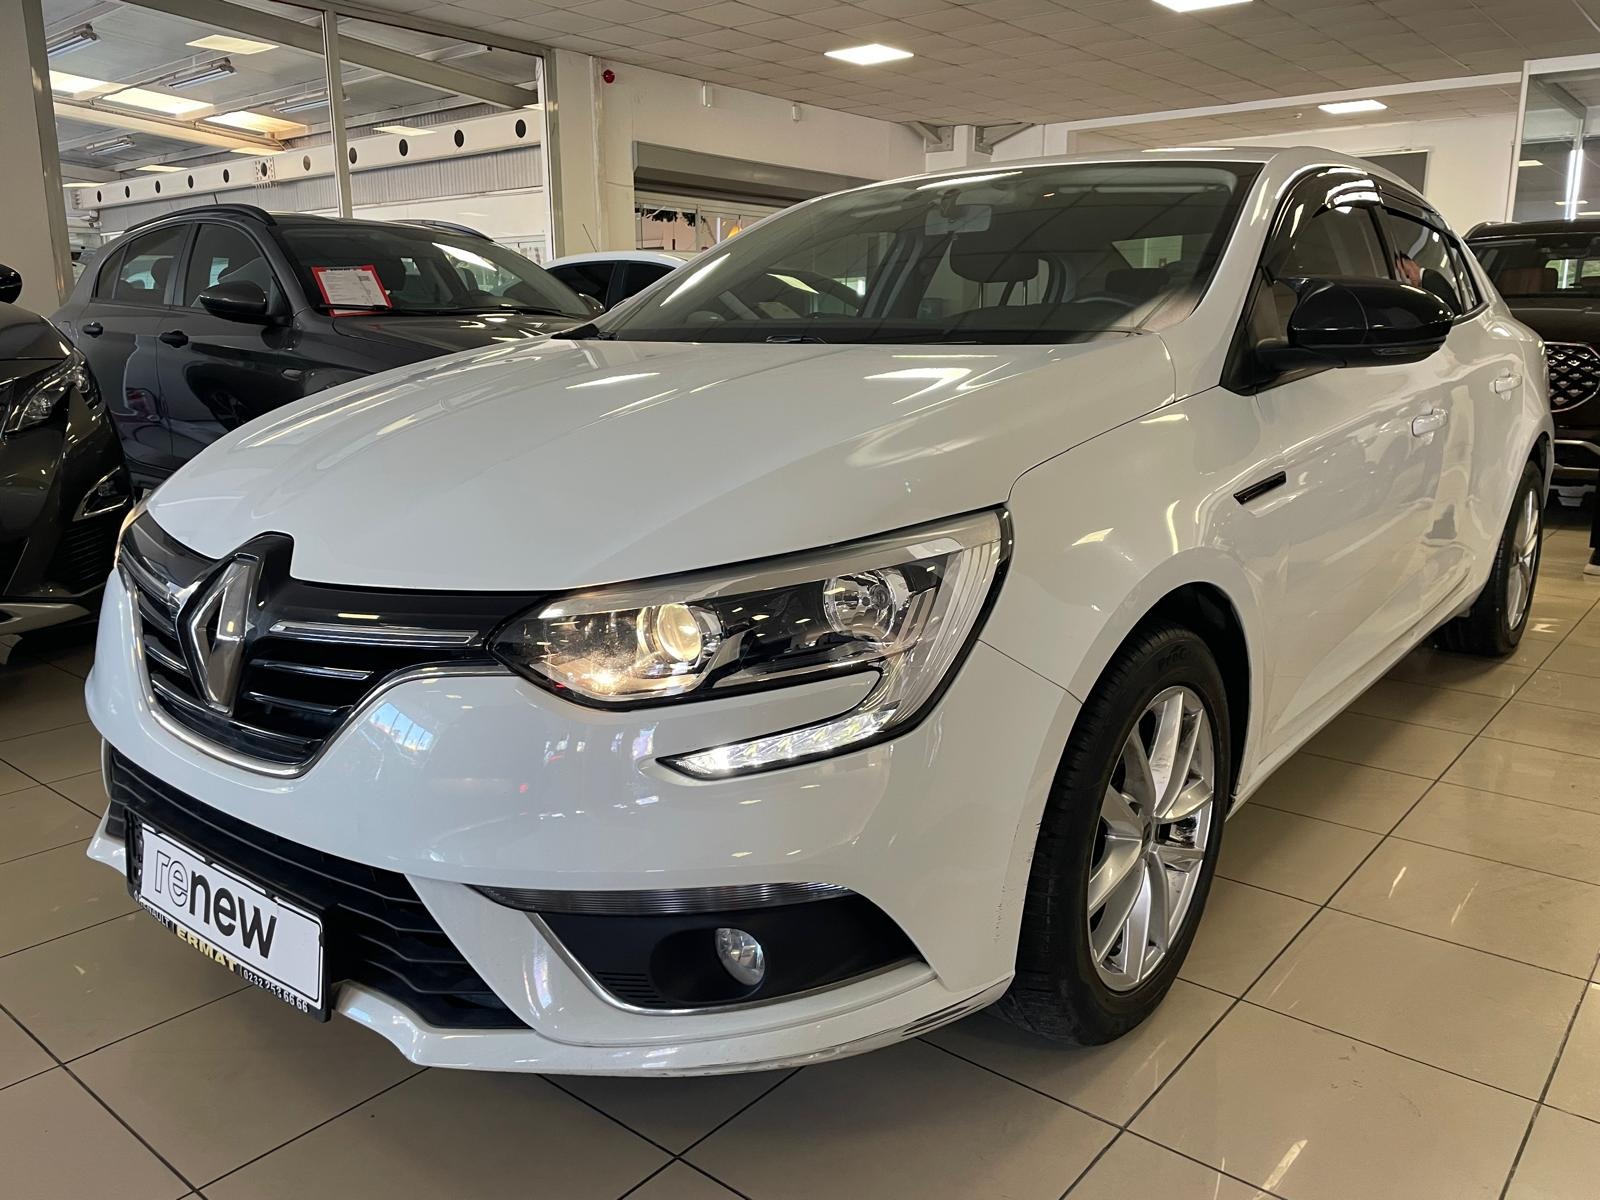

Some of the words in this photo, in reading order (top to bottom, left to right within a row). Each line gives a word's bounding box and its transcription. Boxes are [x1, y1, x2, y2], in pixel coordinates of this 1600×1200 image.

[154, 849, 277, 959] renew
[176, 926, 238, 972] ERMAT
[243, 969, 264, 988] 0232
[283, 990, 295, 1006] 66
[296, 997, 308, 1013] 66
